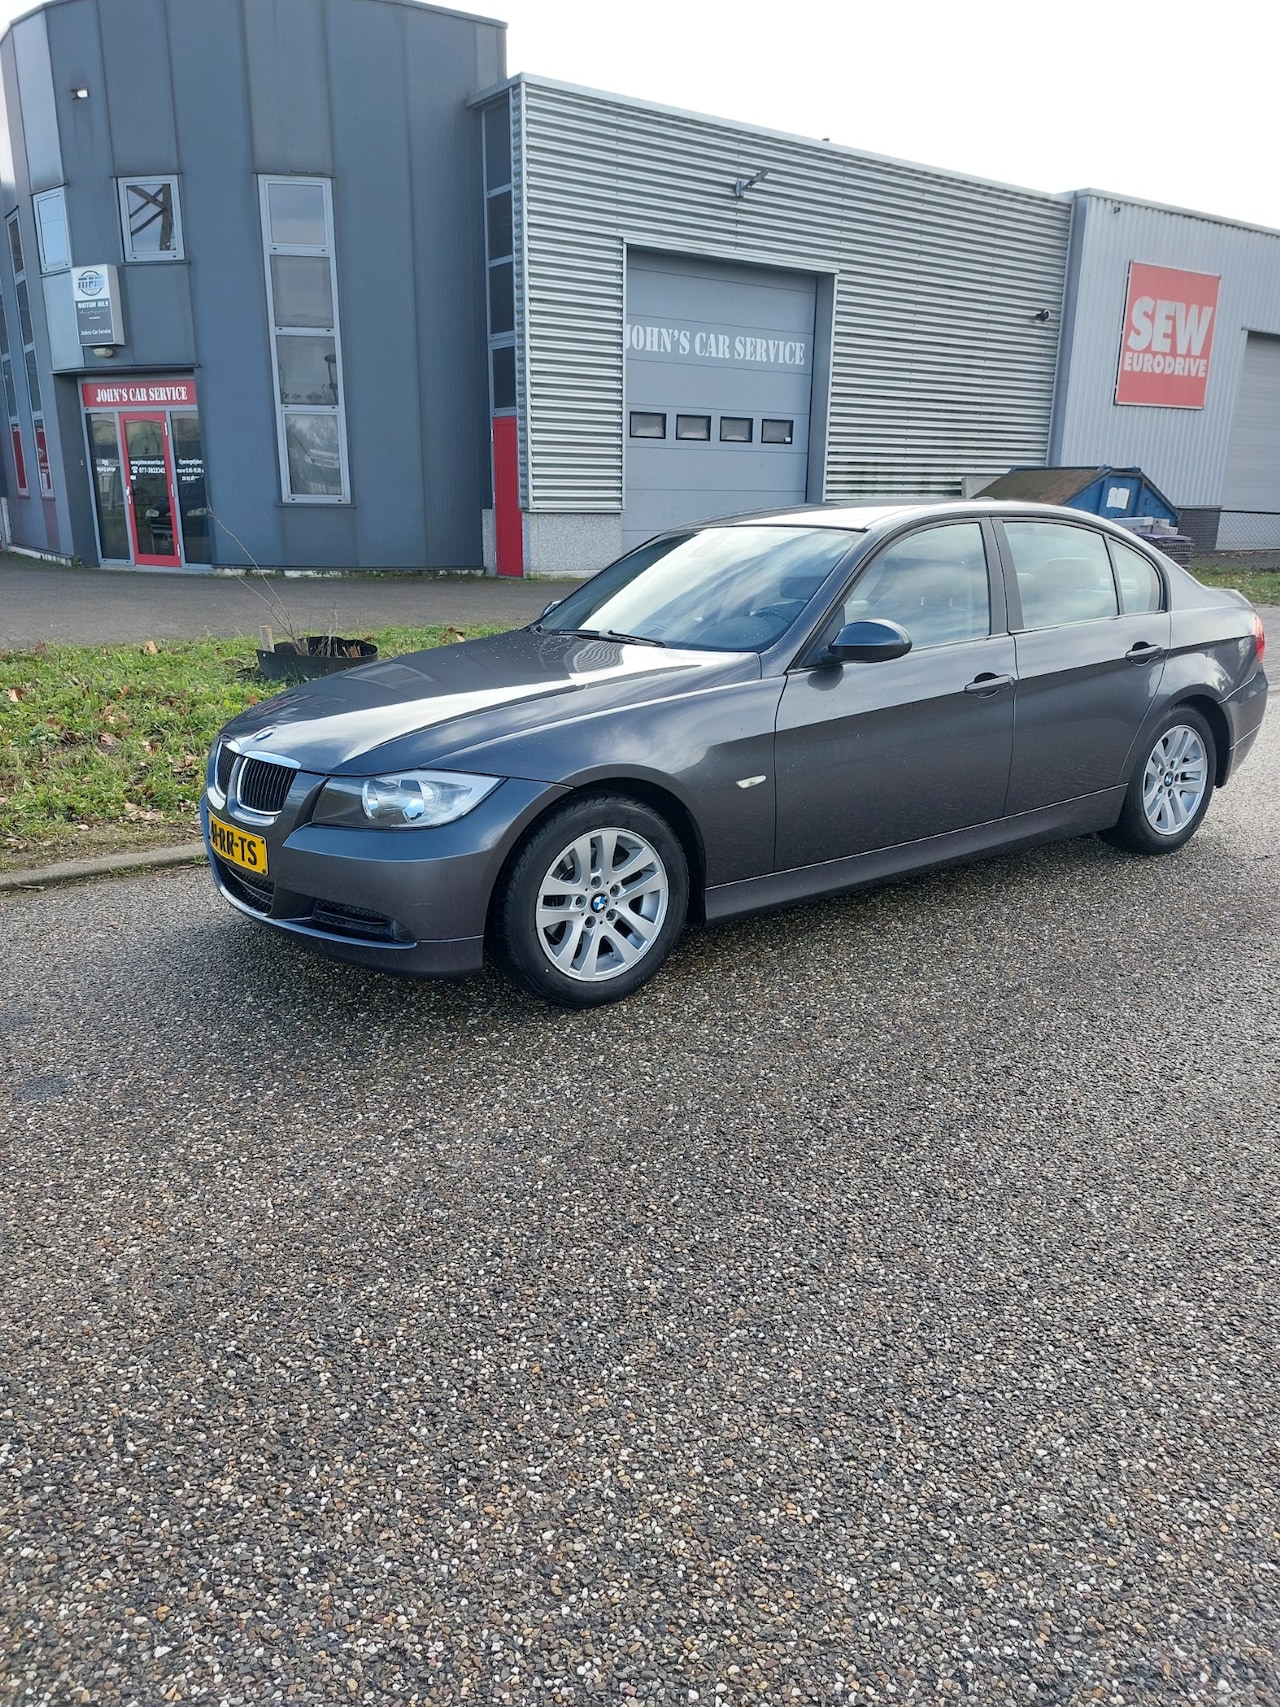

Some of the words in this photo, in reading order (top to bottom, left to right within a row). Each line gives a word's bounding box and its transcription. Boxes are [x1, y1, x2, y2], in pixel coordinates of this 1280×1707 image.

[1126, 295, 1214, 357] SEW
[694, 331, 731, 360] CAR
[734, 335, 805, 366] SERVICE
[1123, 351, 1207, 378] EURODRIVE
[96, 387, 128, 403] JOHN'S
[129, 387, 148, 402] CAR
[149, 386, 188, 401] SERVICE
